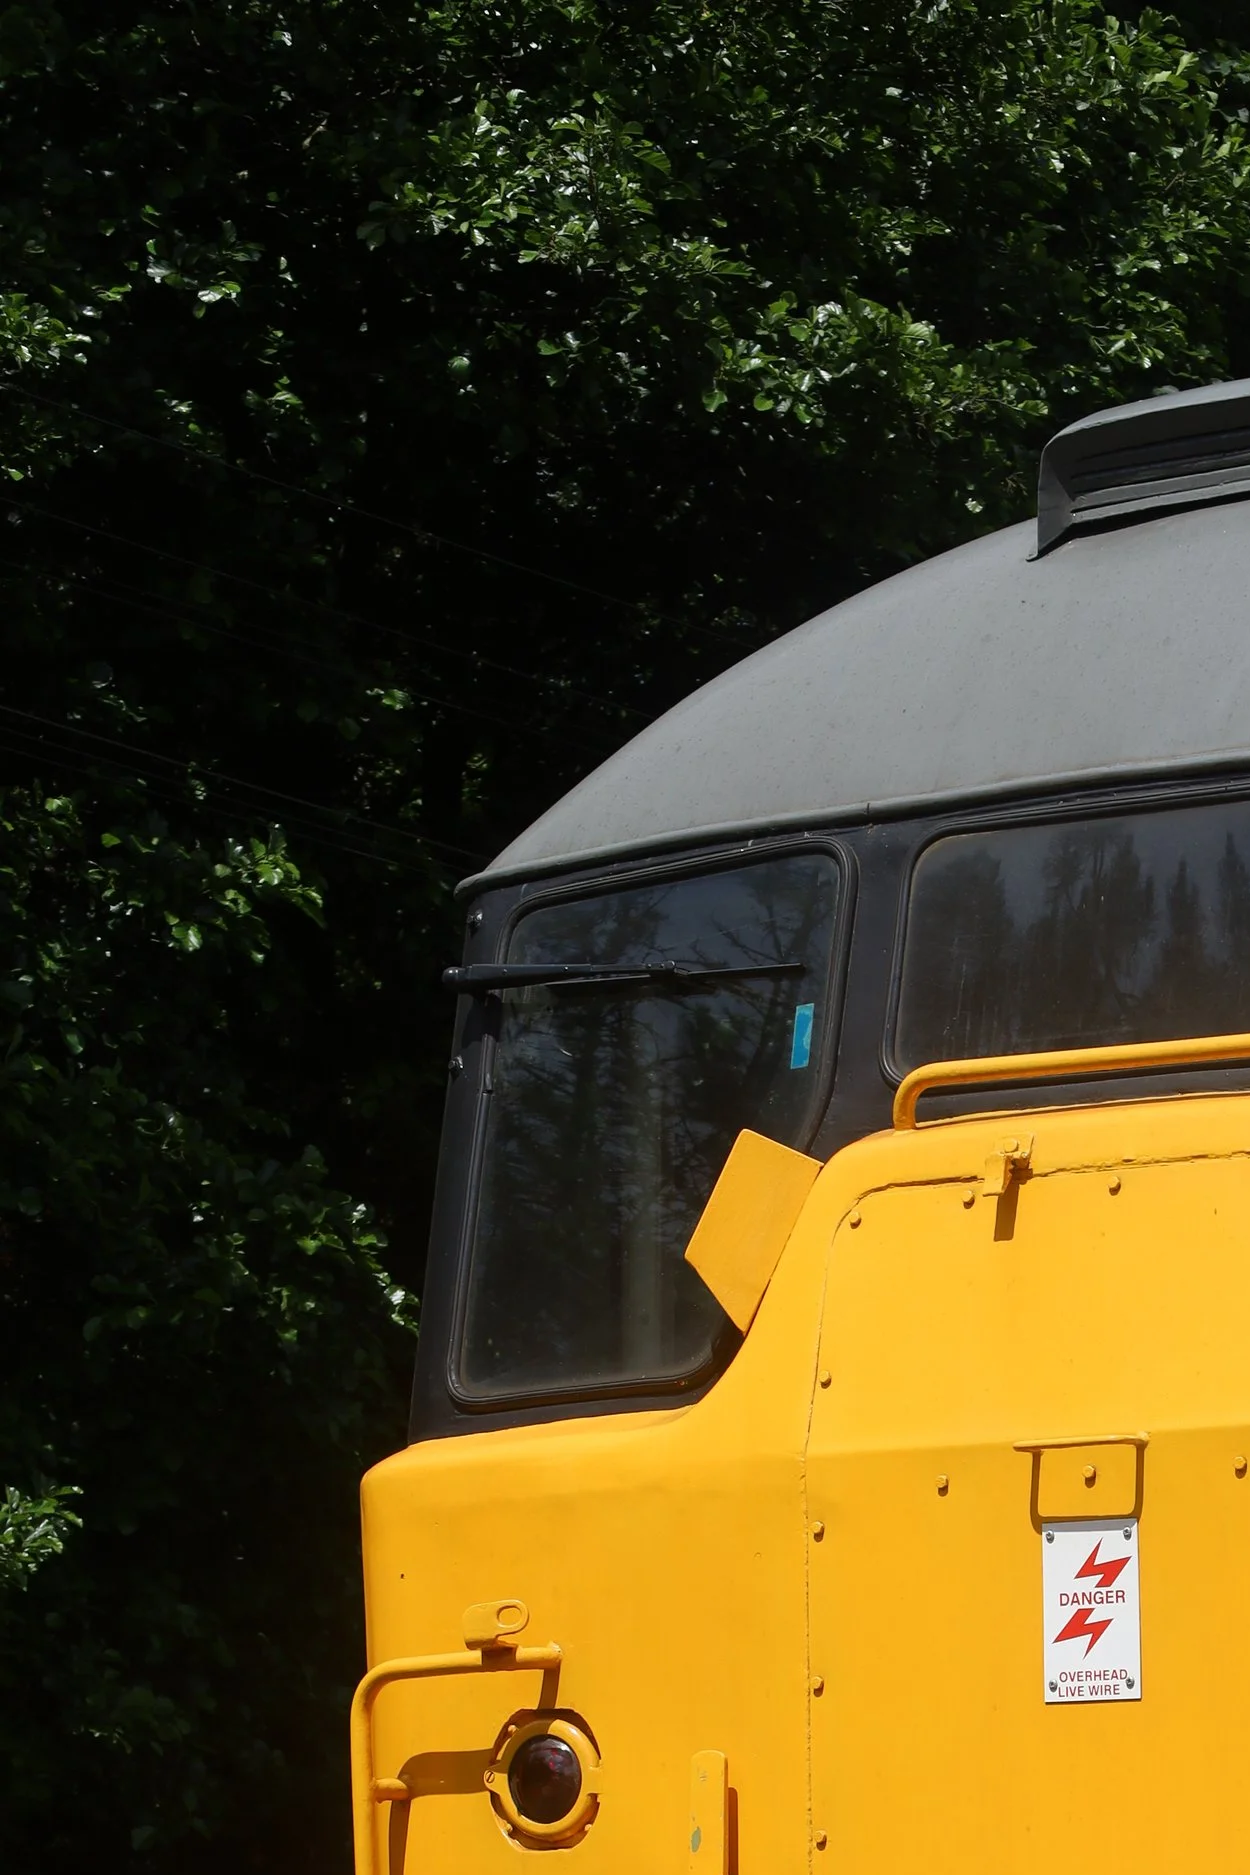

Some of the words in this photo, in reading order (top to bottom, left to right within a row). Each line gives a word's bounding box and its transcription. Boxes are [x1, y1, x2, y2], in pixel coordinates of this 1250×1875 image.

[1059, 1590, 1126, 1606] DANGER
[1059, 1669, 1128, 1683] OVERHEAD
[1058, 1686, 1085, 1698] LIVE
[1088, 1684, 1120, 1697] WIRE
